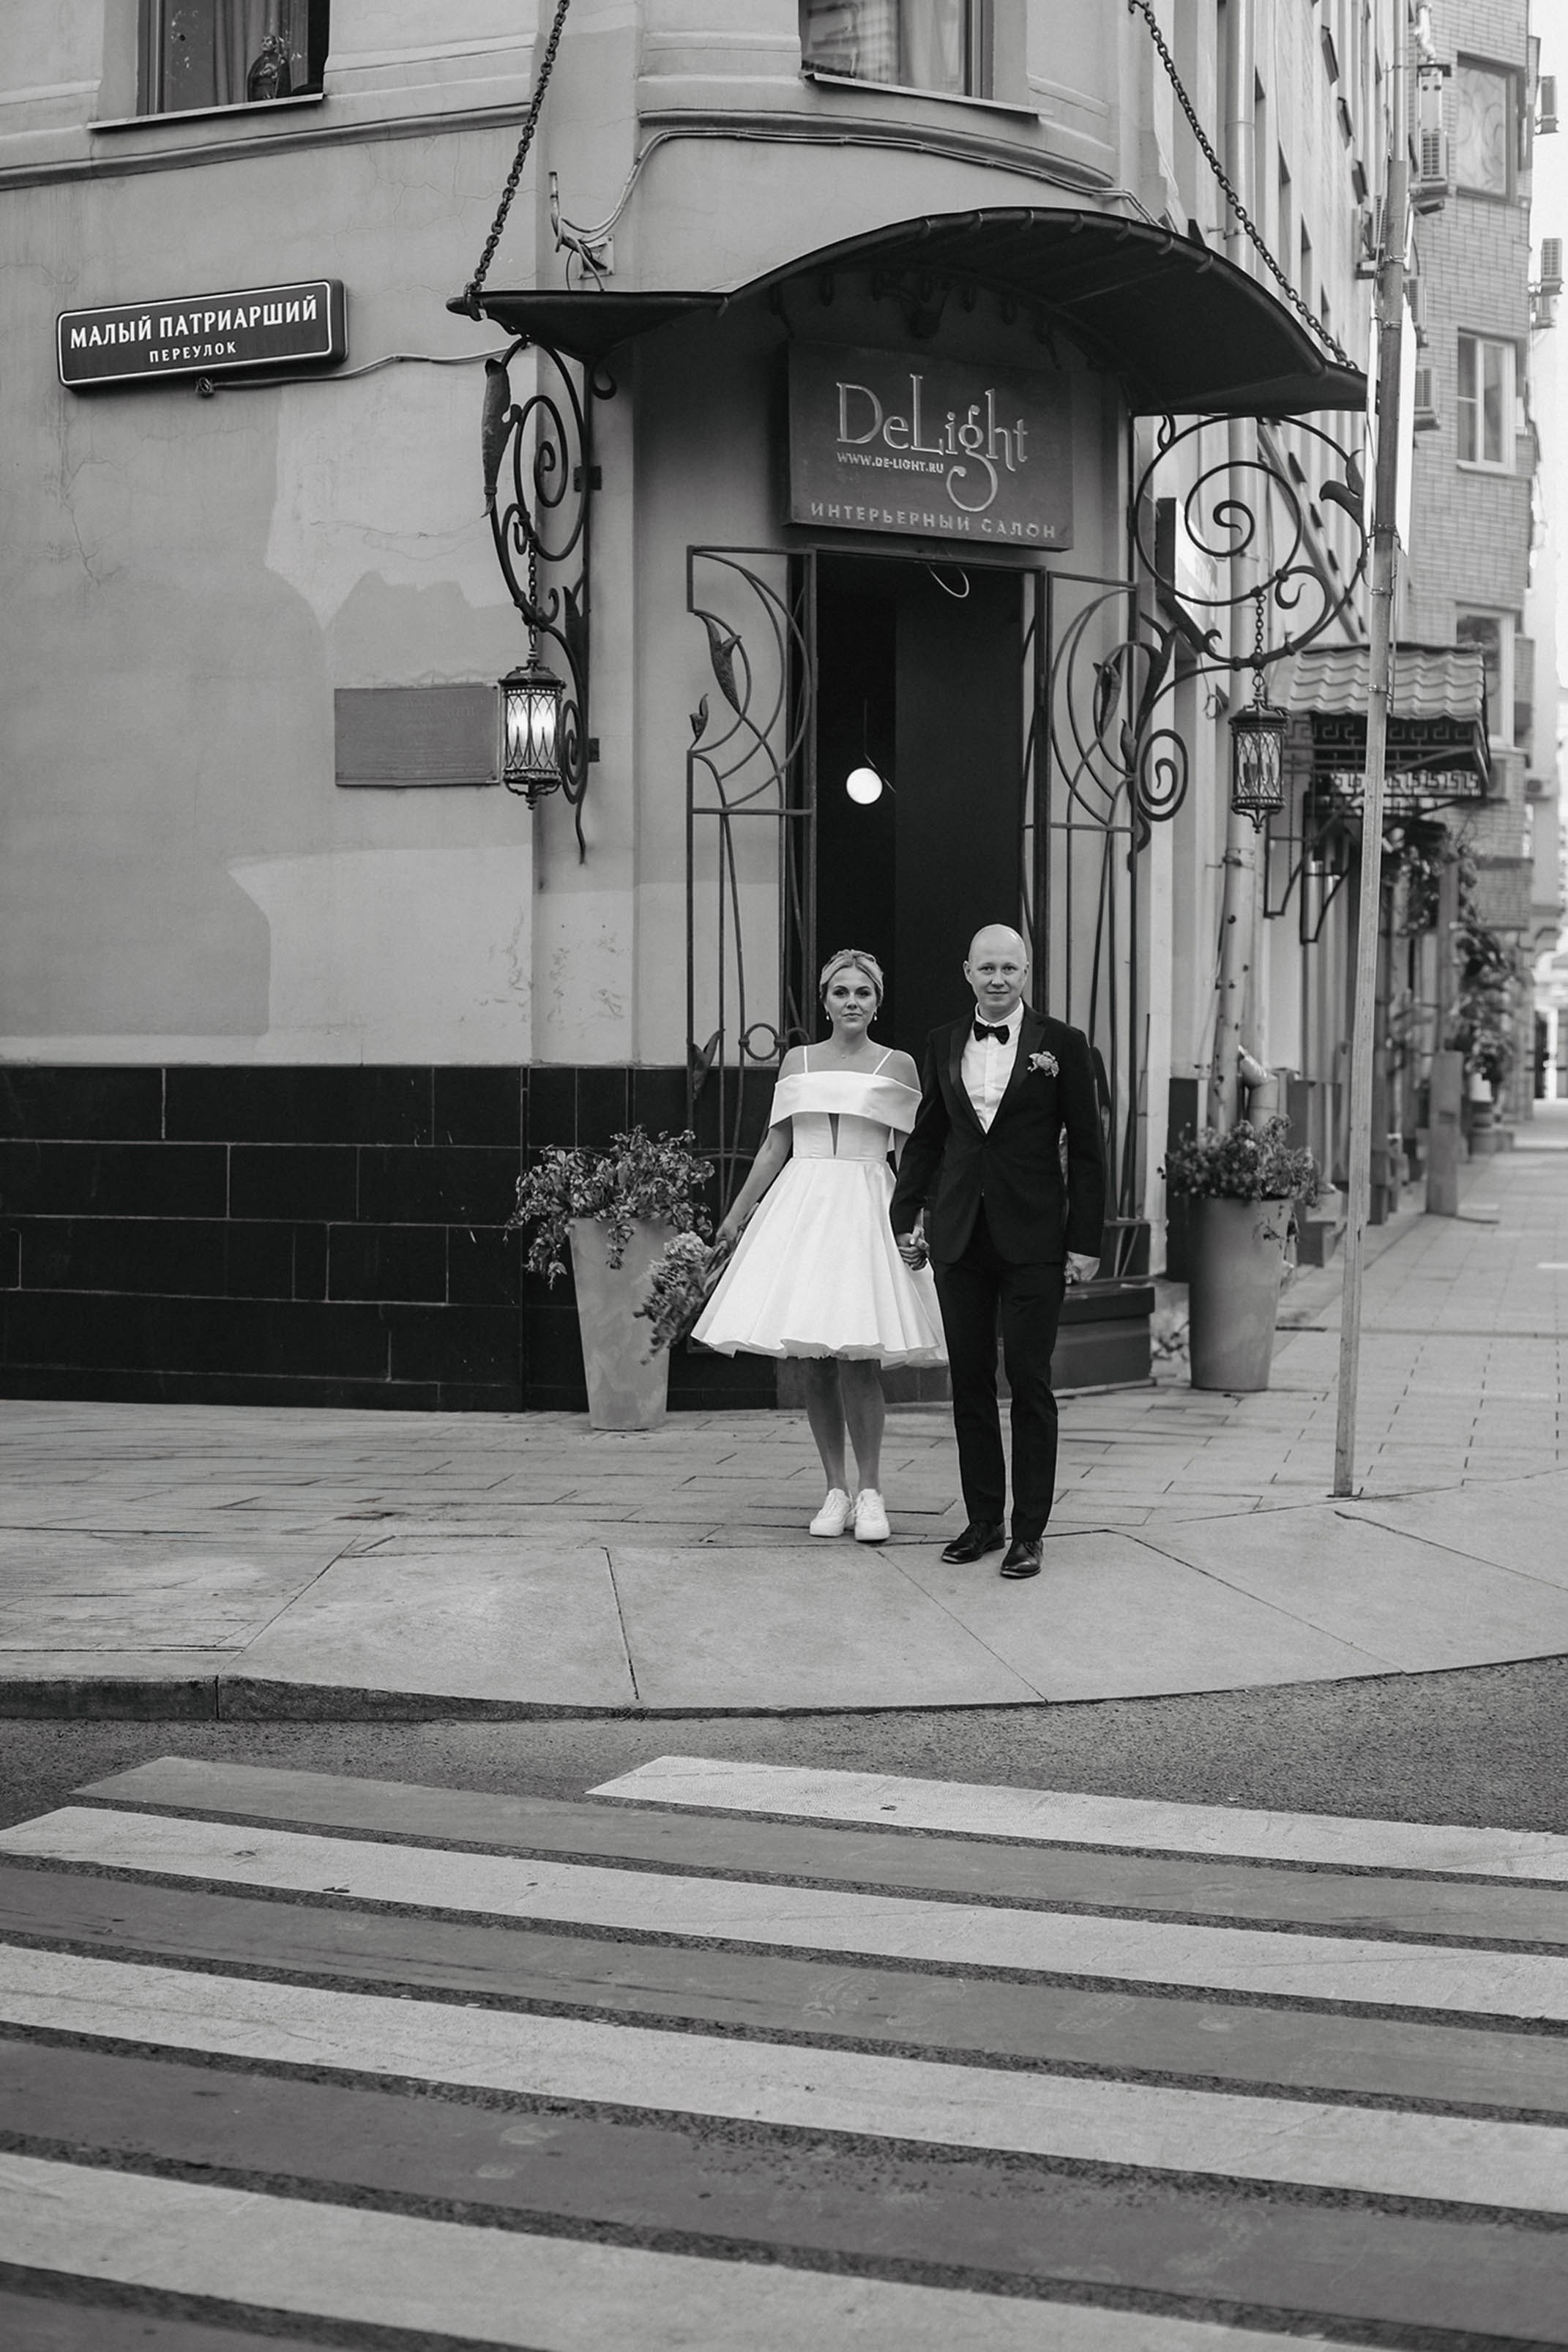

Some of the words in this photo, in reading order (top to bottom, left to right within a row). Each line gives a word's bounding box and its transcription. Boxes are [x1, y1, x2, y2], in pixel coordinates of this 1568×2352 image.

[70, 316, 152, 348] МАЛЫЙ
[160, 295, 317, 338] ПАТРИАРШИЙ
[149, 342, 237, 363] ПЕРЕУЛОК
[836, 374, 1028, 512] DeLight
[837, 452, 944, 474] WWW.DE-LIGHT.RU
[810, 502, 970, 531] ИНТЕРЬЕРНЫЙ
[981, 518, 1056, 539] САЛОН
